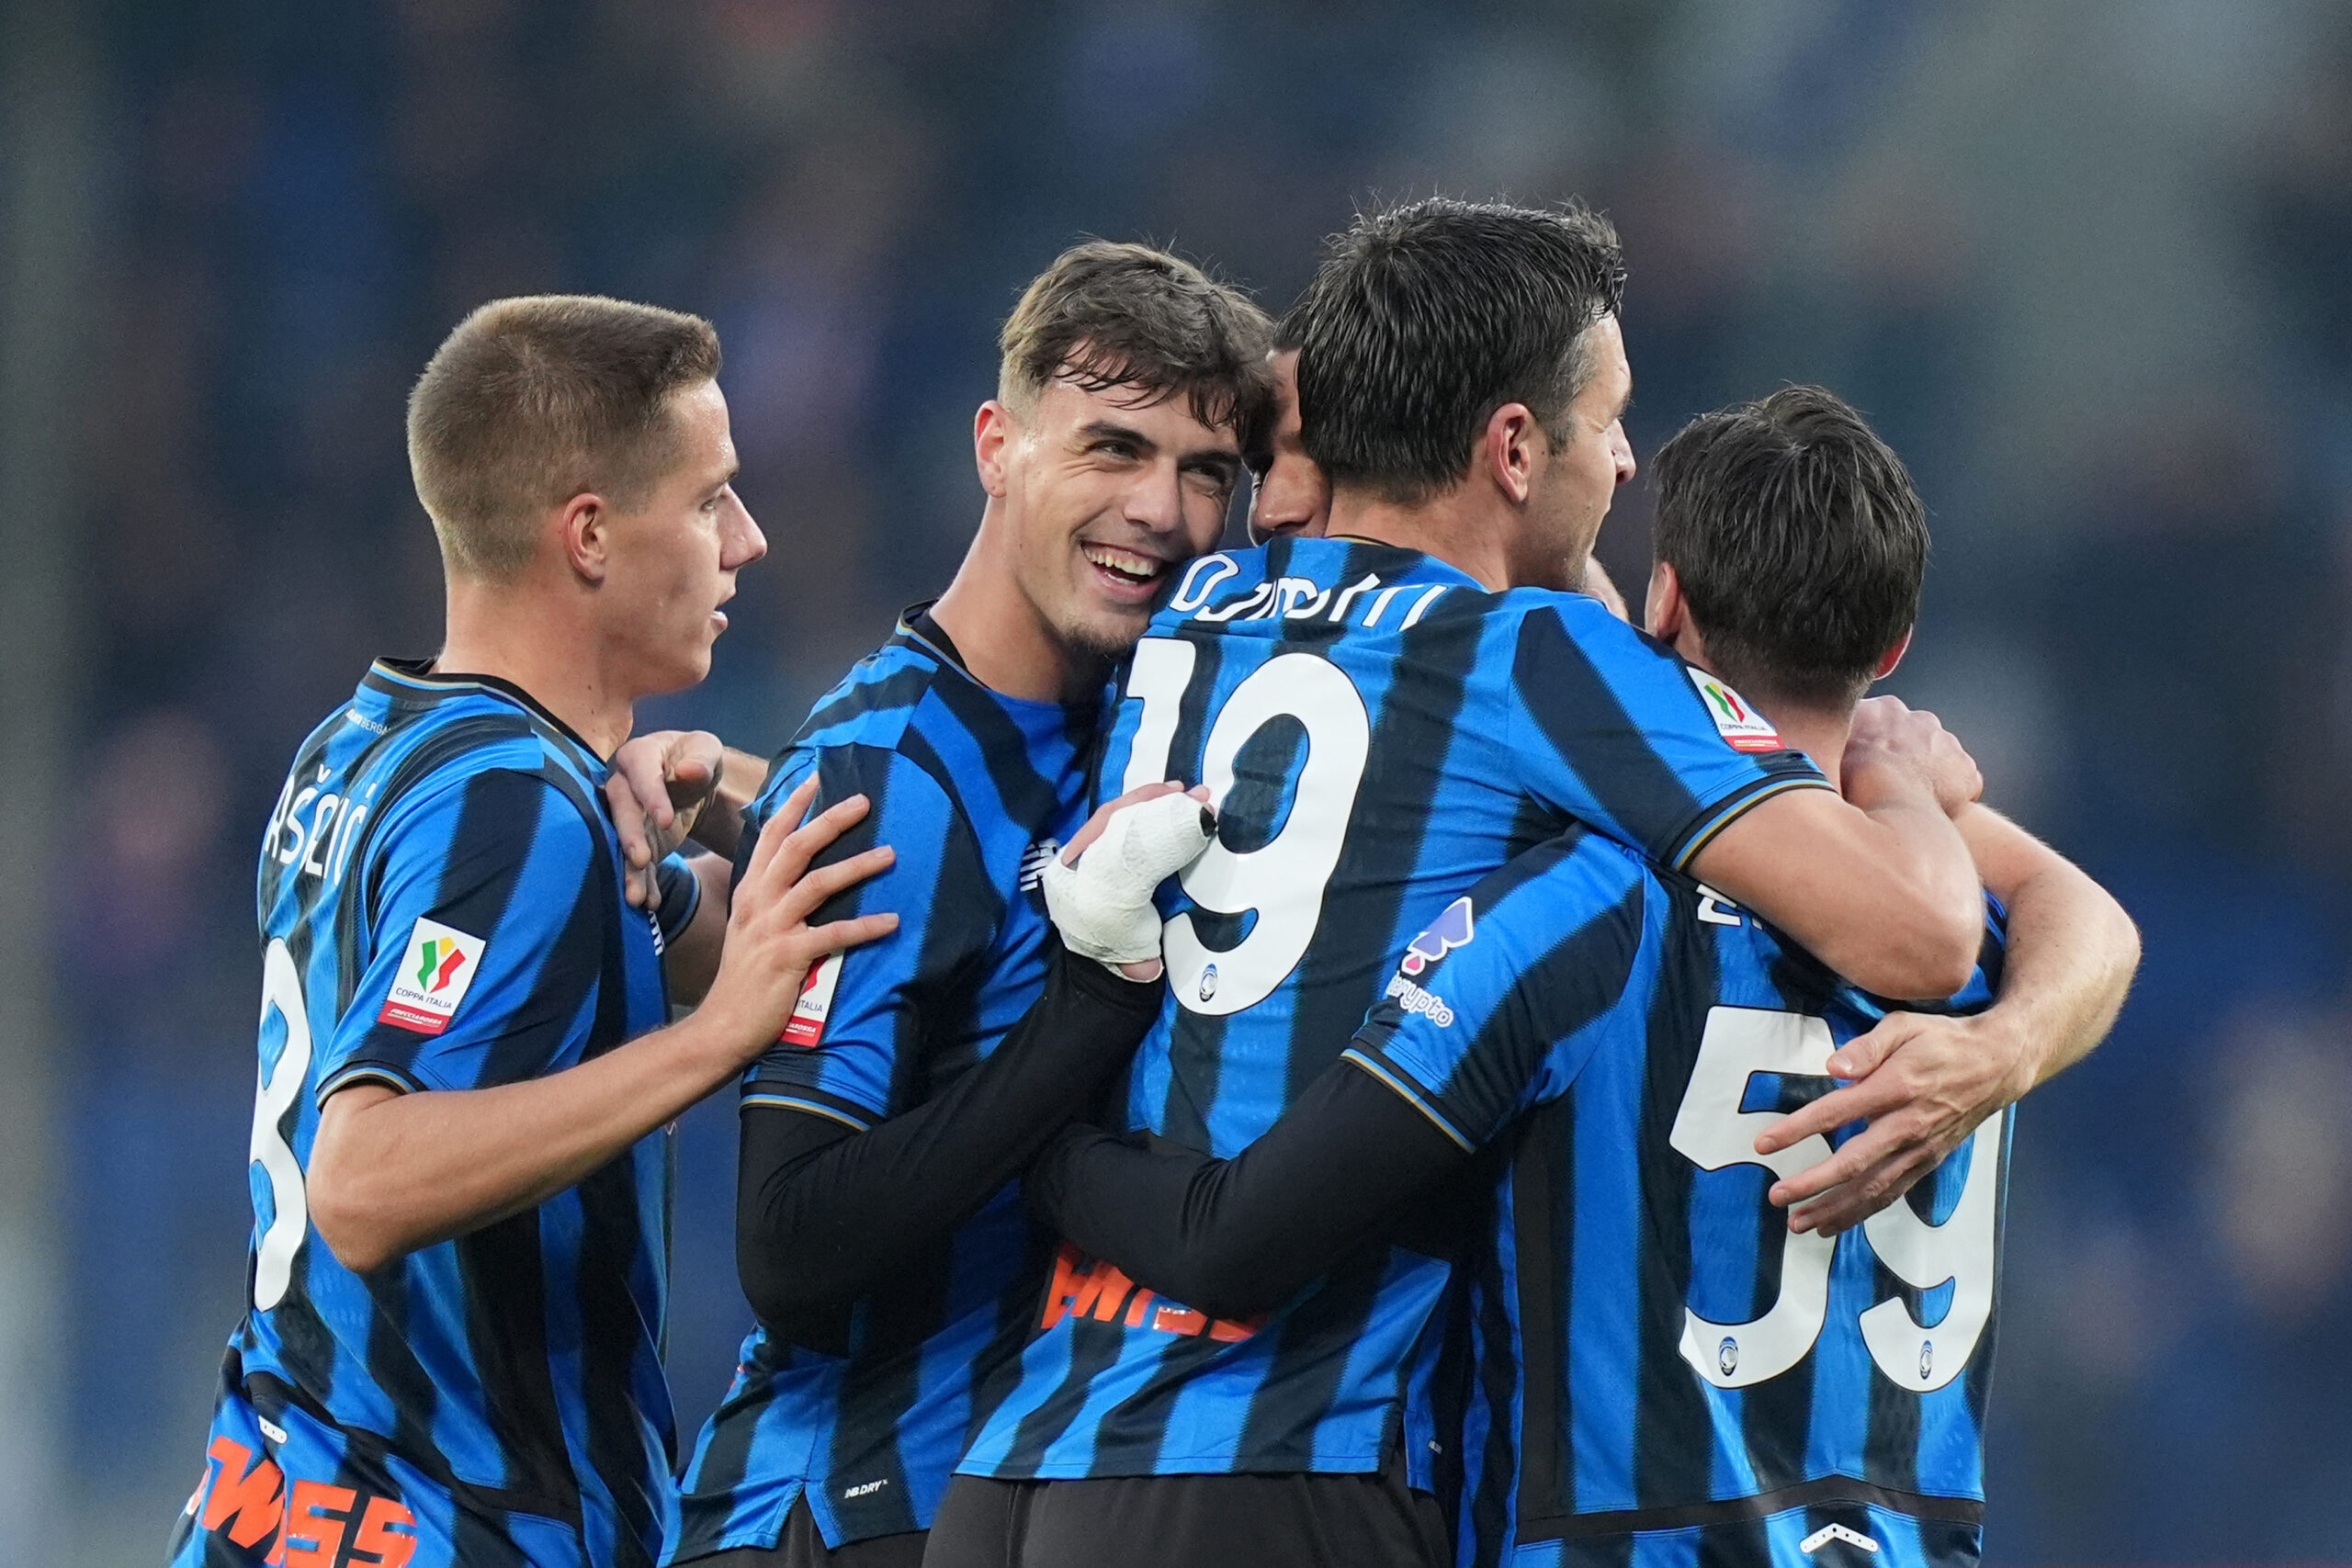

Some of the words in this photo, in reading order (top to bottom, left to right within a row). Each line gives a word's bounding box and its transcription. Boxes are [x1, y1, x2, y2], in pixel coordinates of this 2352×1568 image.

[1121, 637, 1370, 1016] 19
[395, 987, 424, 1002] COPPA
[425, 997, 453, 1010] ITALIA
[797, 999, 823, 1013] ITALIA
[1669, 1005, 2004, 1393] 59
